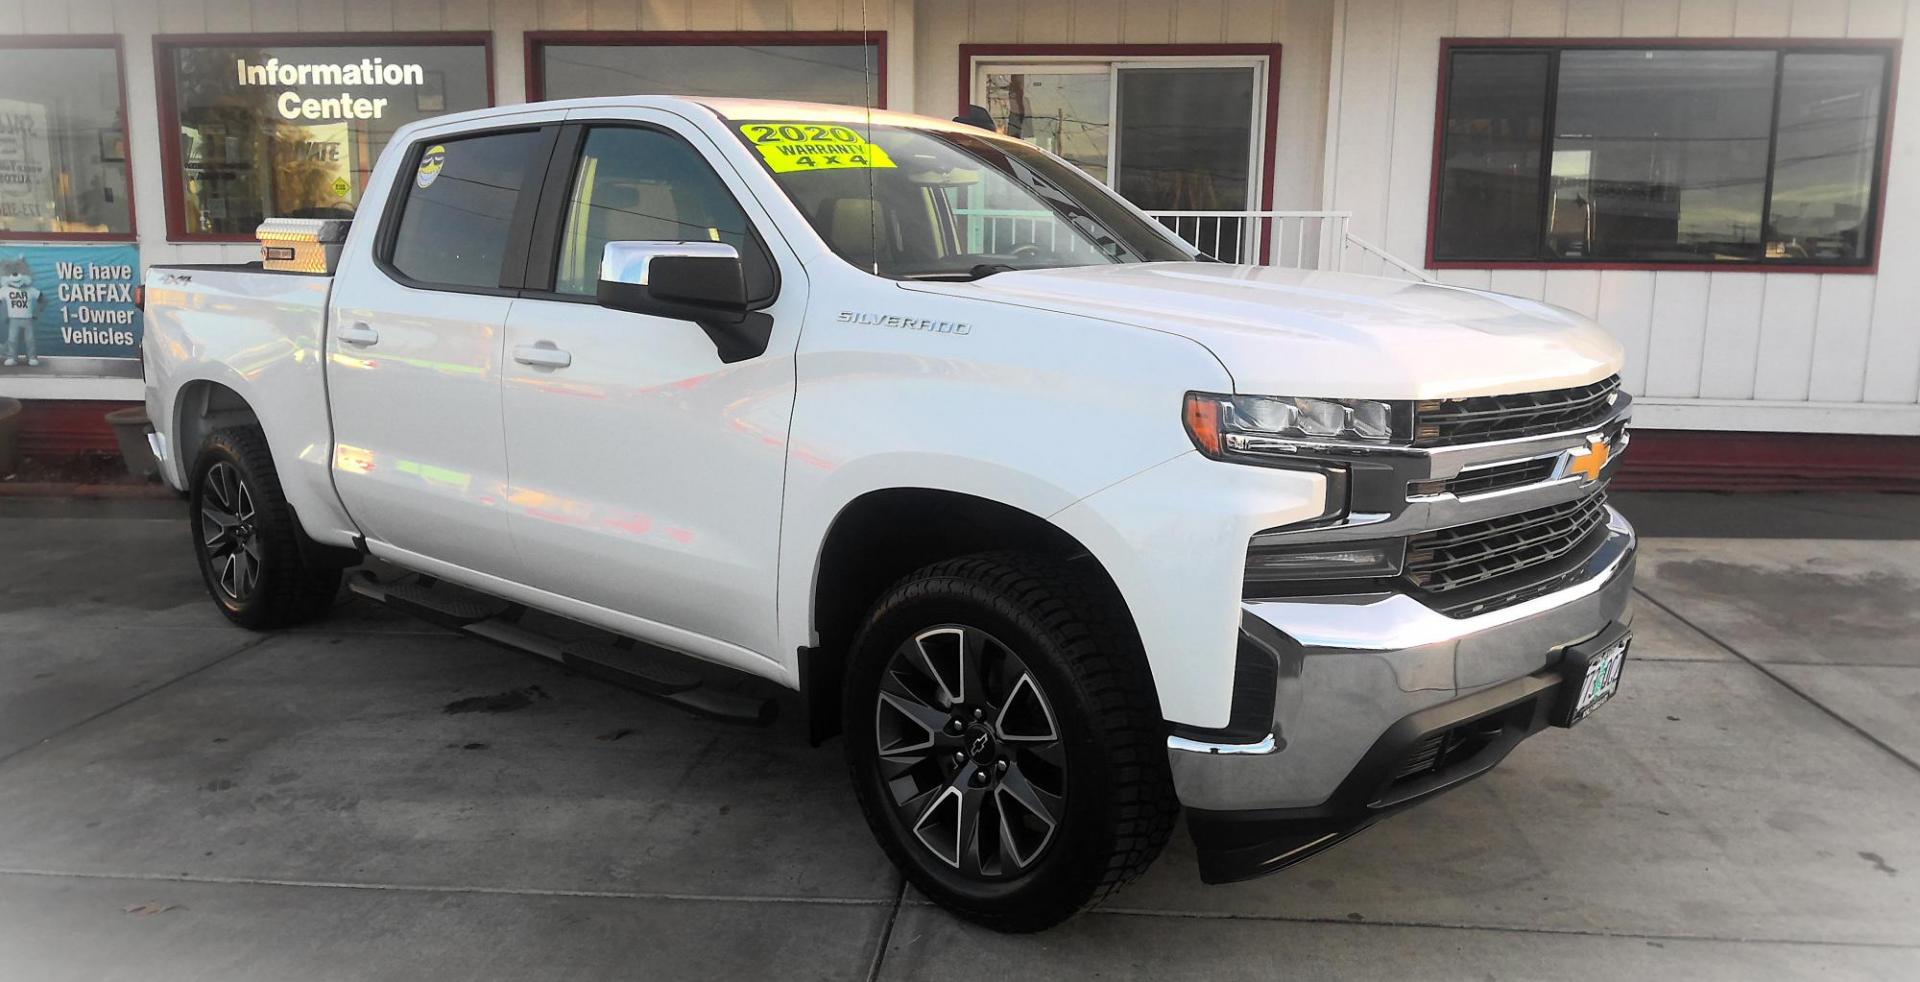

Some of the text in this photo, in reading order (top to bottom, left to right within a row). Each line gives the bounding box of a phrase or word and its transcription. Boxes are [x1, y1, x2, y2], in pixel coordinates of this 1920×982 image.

[237, 57, 423, 86] Information
[277, 91, 388, 119] Center
[751, 125, 857, 143] 2020
[776, 144, 864, 156] WARRANTY
[56, 261, 132, 280] We have
[9, 291, 28, 300] CAR
[58, 283, 133, 303] CARFAX
[11, 300, 29, 309] FOX
[60, 305, 135, 324] 1-Owner
[836, 311, 972, 335] SILVERADO
[61, 326, 134, 345] Vehicles
